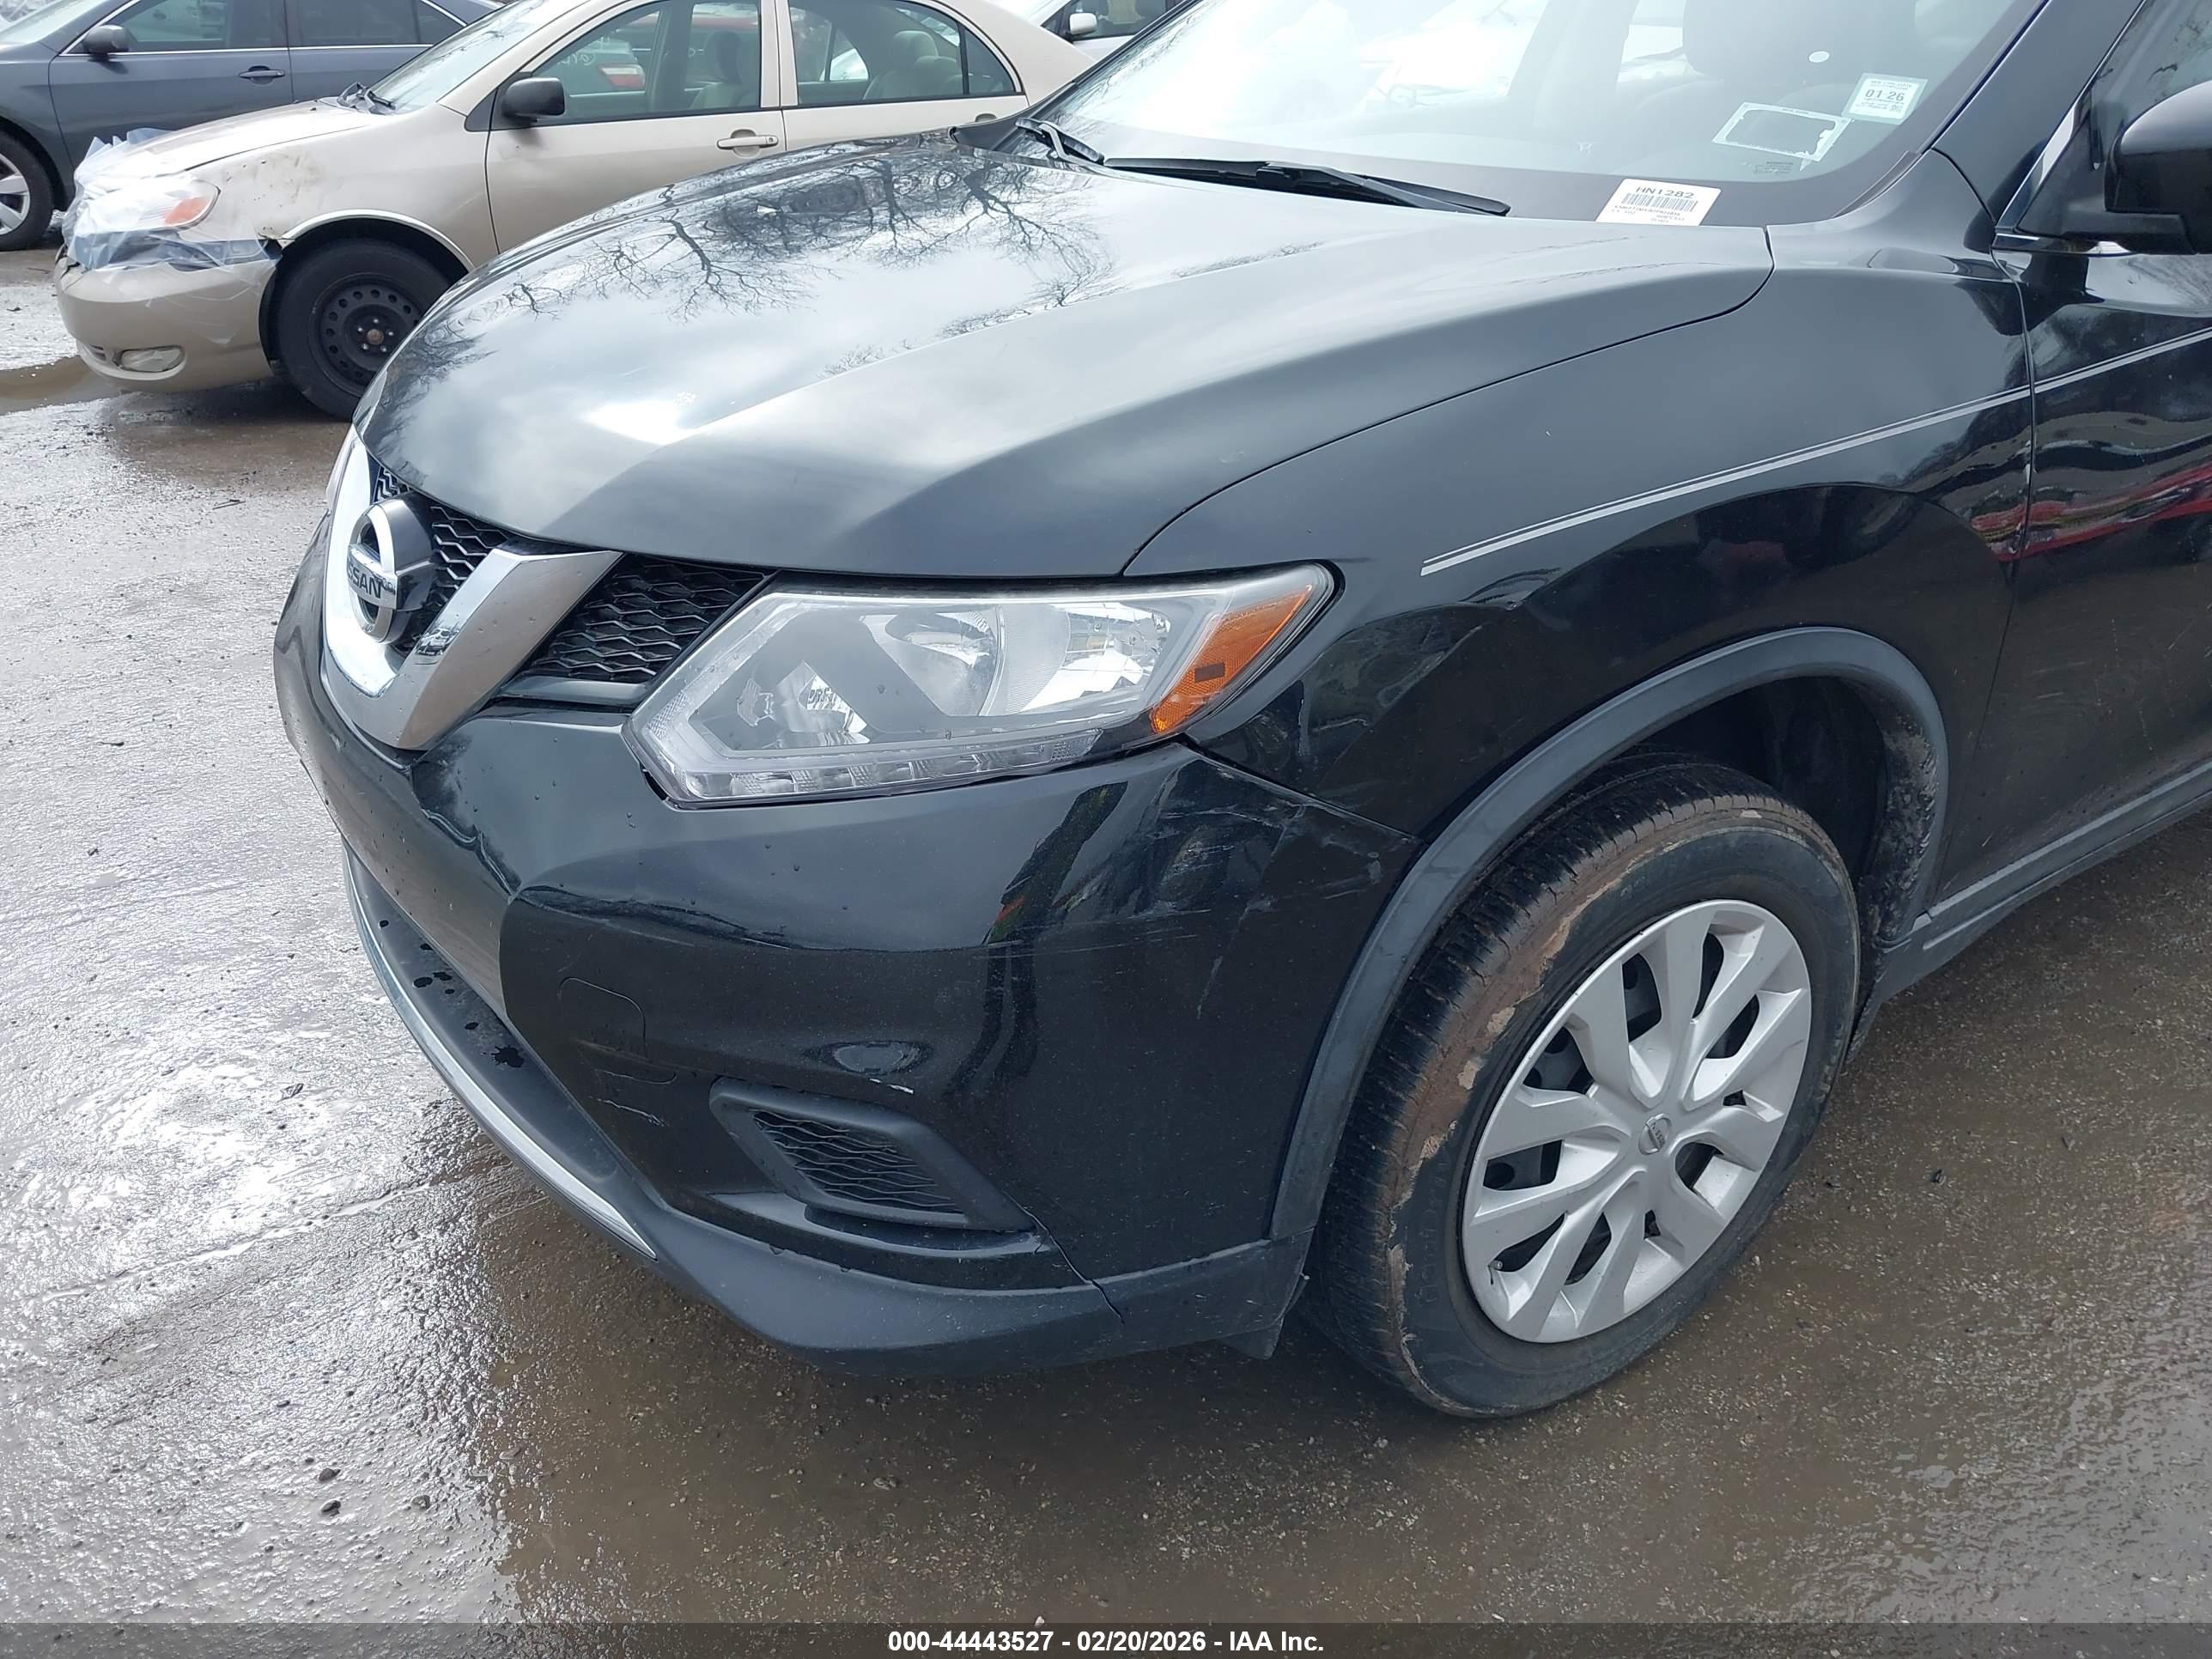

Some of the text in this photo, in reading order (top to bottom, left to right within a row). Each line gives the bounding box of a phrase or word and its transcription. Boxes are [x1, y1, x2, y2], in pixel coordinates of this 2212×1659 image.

[1865, 88, 1905, 101] 01 26
[1635, 186, 1695, 199] HN1282
[347, 560, 382, 599] SSAN
